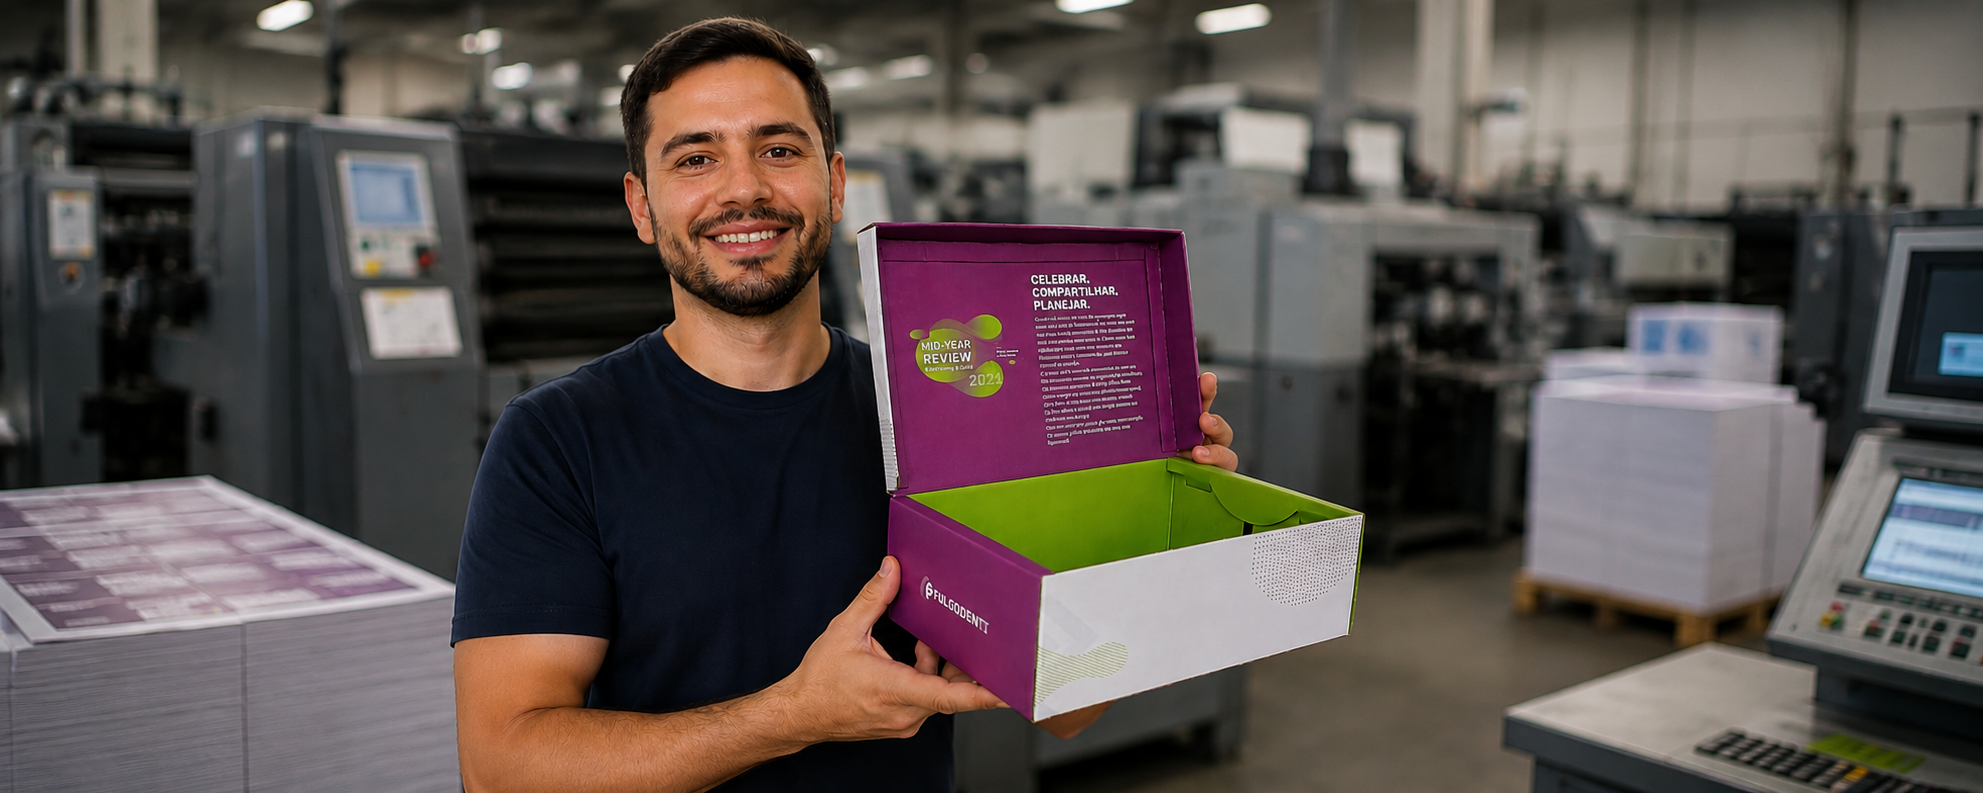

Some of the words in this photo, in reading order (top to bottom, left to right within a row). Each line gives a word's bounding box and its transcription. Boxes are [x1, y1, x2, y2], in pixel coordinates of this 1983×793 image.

[1030, 273, 1090, 285] CELEBRAR.
[1032, 286, 1119, 298] COMPARTILHAR.
[1033, 299, 1091, 311] PLANEJAR.
[921, 339, 971, 351] MID-YEAR
[923, 351, 972, 365] REVIEW
[969, 372, 1003, 387] 2021
